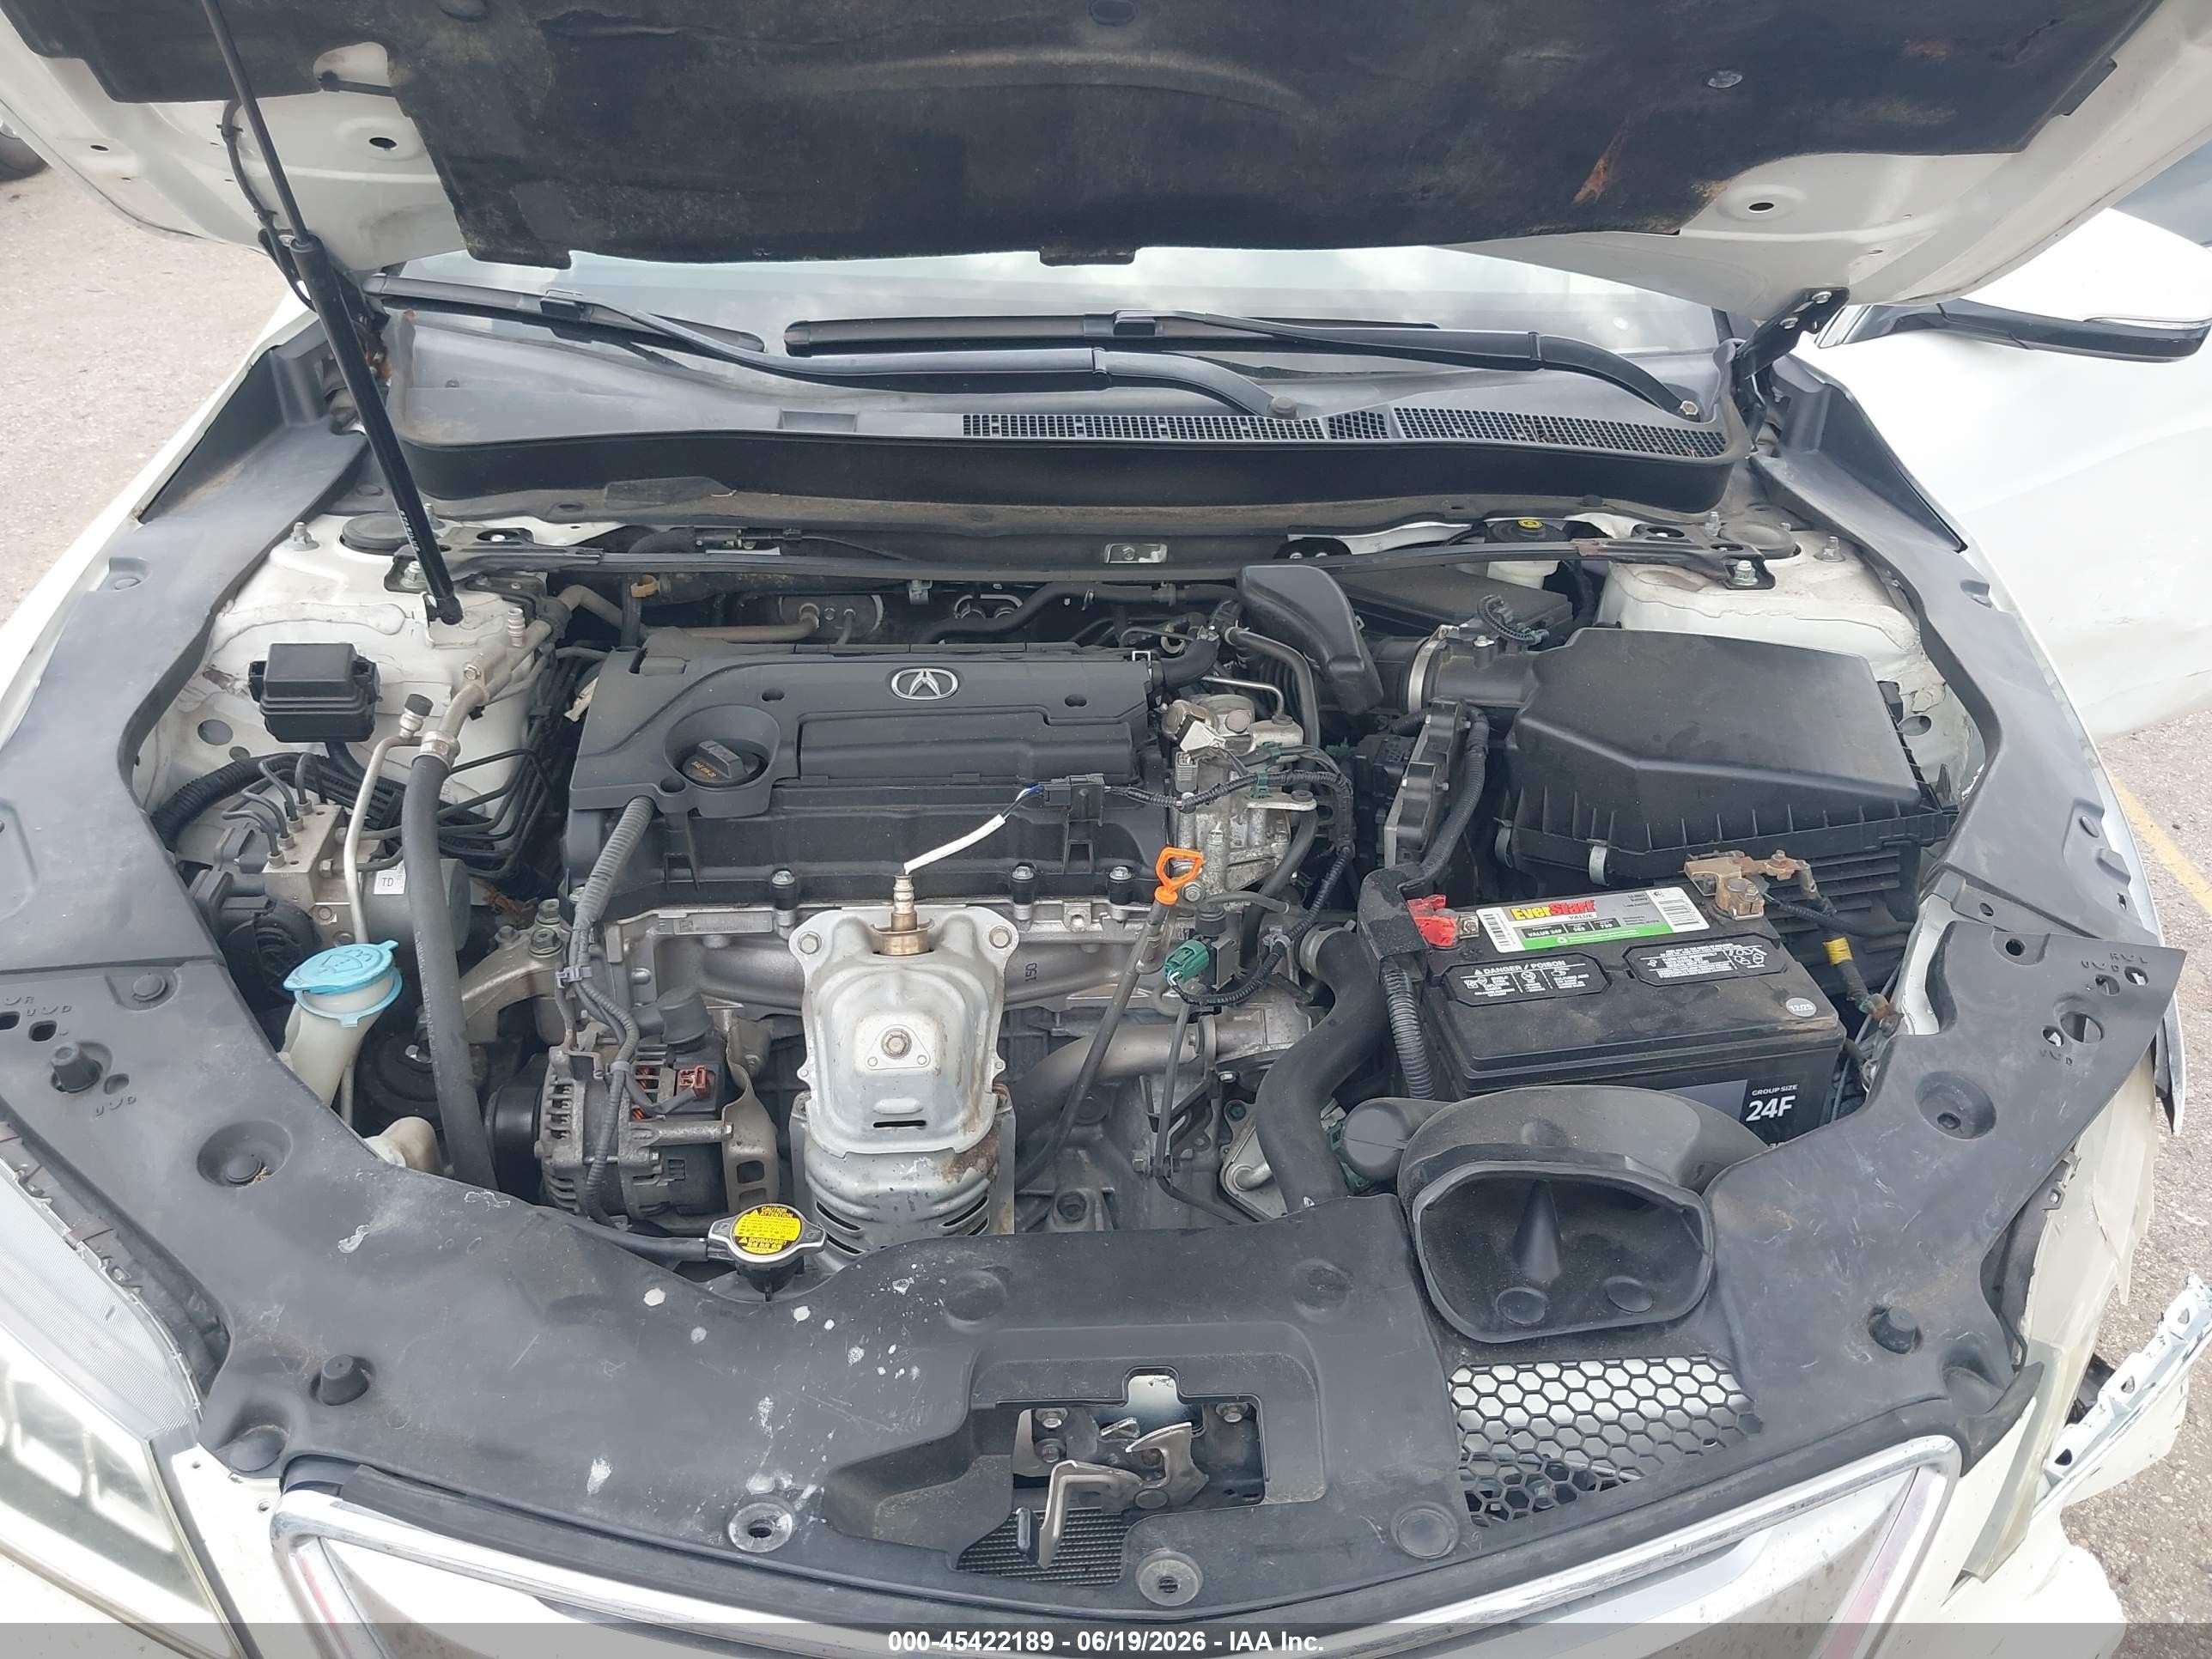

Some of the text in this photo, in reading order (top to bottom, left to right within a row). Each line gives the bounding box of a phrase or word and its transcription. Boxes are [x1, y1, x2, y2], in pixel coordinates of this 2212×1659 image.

[382, 878, 393, 886] TD
[1510, 899, 1595, 921] EverStart
[1527, 929, 1549, 938] VALUE
[1483, 965, 1523, 975] DANGER
[1530, 960, 1566, 969] POISON
[1752, 1084, 1799, 1097] GROUP SIZE
[1746, 1095, 1796, 1122] 24F
